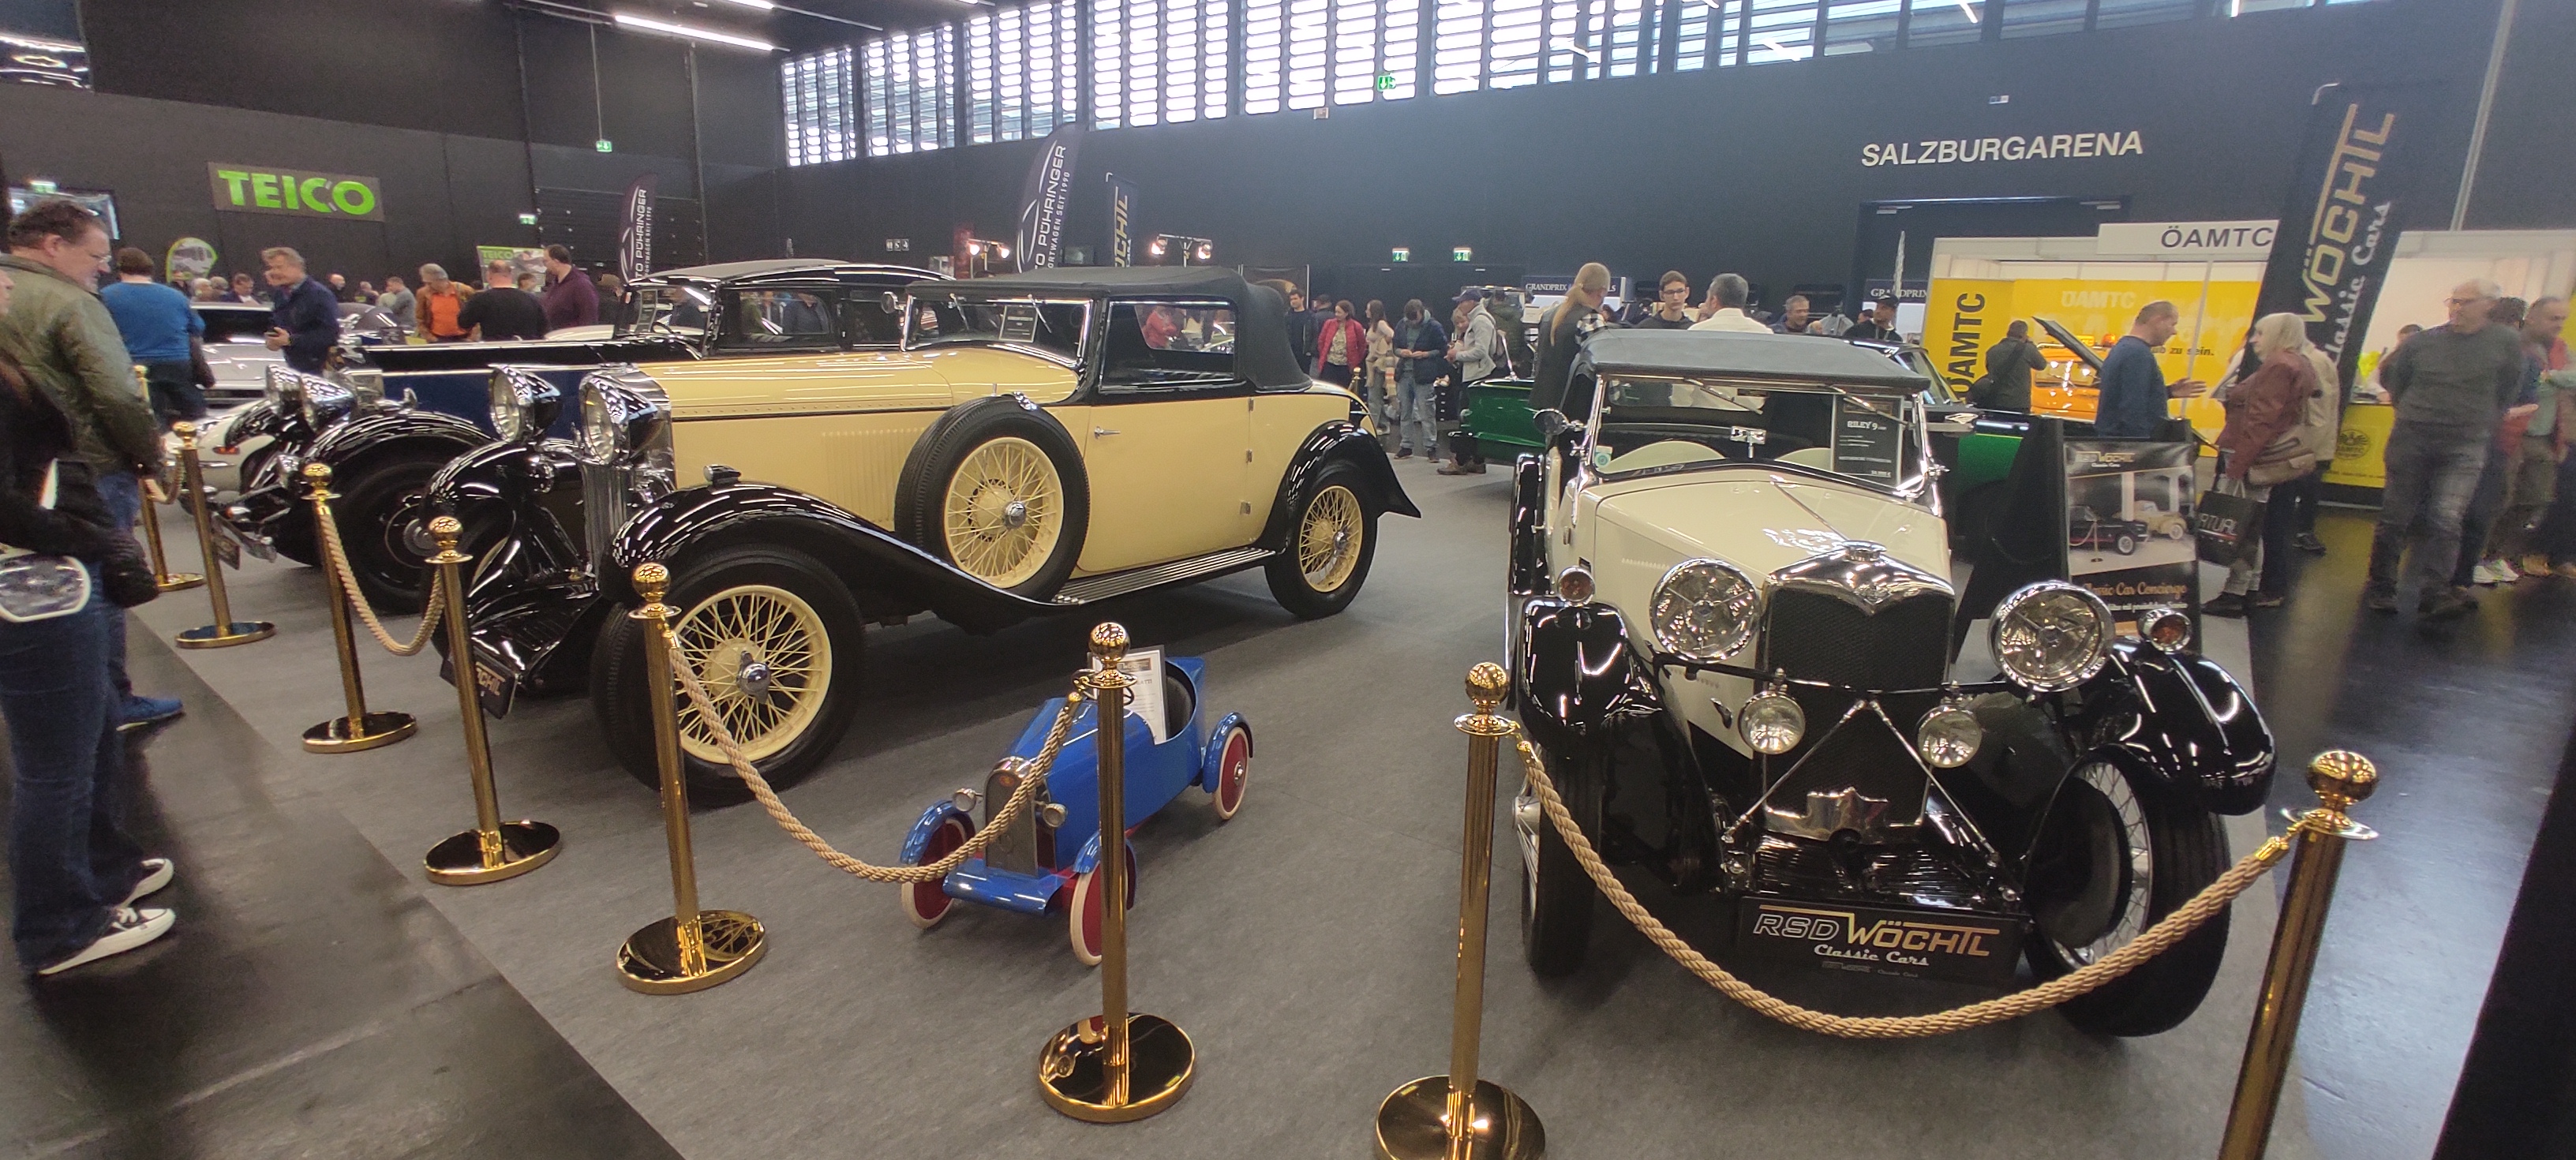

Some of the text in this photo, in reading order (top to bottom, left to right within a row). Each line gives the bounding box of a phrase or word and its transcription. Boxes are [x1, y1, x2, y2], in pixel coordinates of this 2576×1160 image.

[1862, 131, 2144, 167] SALZBURGARENA
[218, 170, 376, 215] TEICO
[1038, 145, 1066, 247] PÜHRINGER
[635, 189, 647, 259] PÜHRINGER
[1047, 171, 1071, 269] ORTWAGEN SEIT 1990
[2161, 225, 2274, 248] ÖAMTC
[2352, 200, 2391, 267] Cars
[1870, 288, 1927, 298] GRDPRIX
[1872, 422, 1878, 431] 9
[1753, 913, 2001, 956] RSD WÖCHTL
[1814, 944, 1930, 967] Classic Cars
